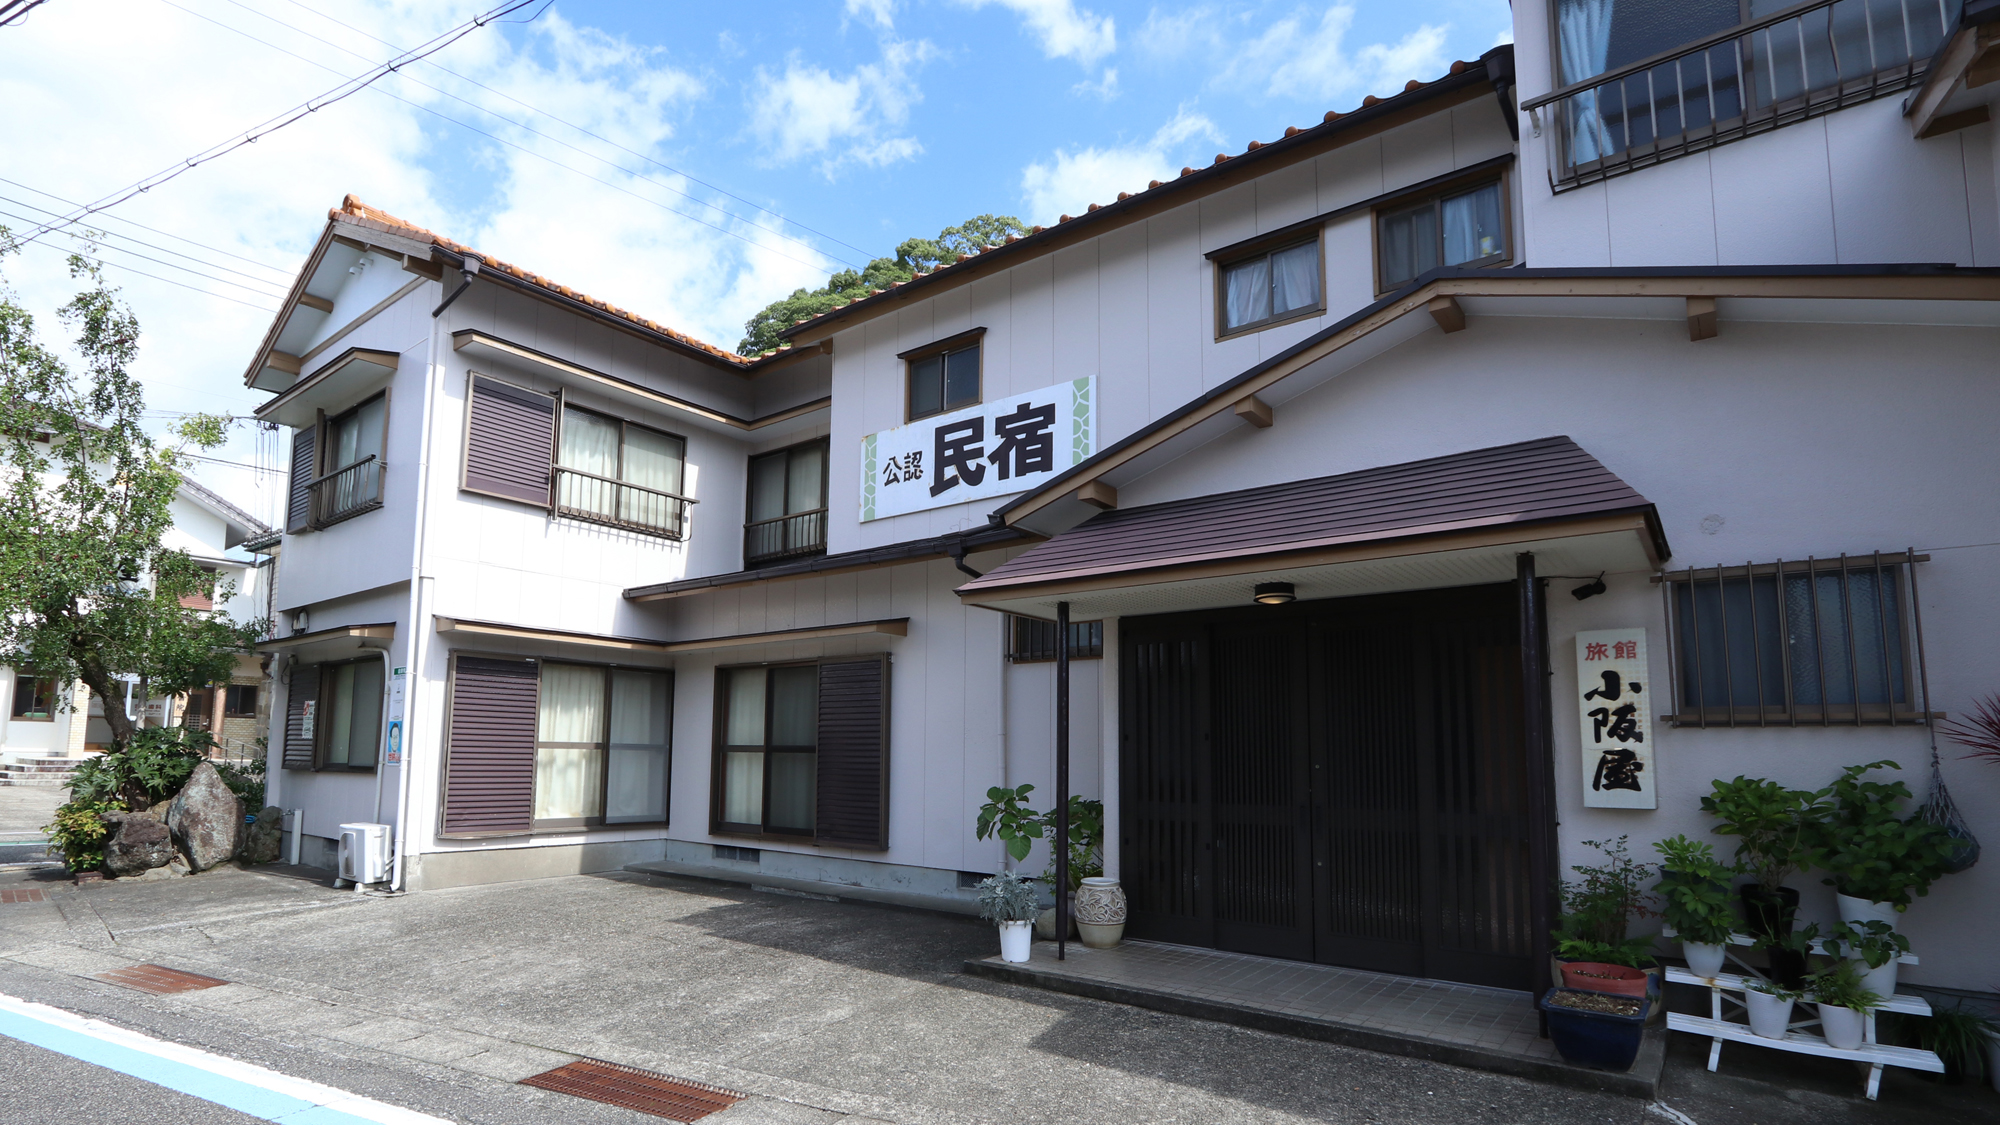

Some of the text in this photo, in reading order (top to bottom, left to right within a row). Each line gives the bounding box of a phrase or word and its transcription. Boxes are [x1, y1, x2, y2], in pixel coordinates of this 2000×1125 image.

[883, 402, 1056, 498] 公認 民宿
[1584, 640, 1637, 661] 旅館
[1584, 670, 1645, 792] 小阪屋
